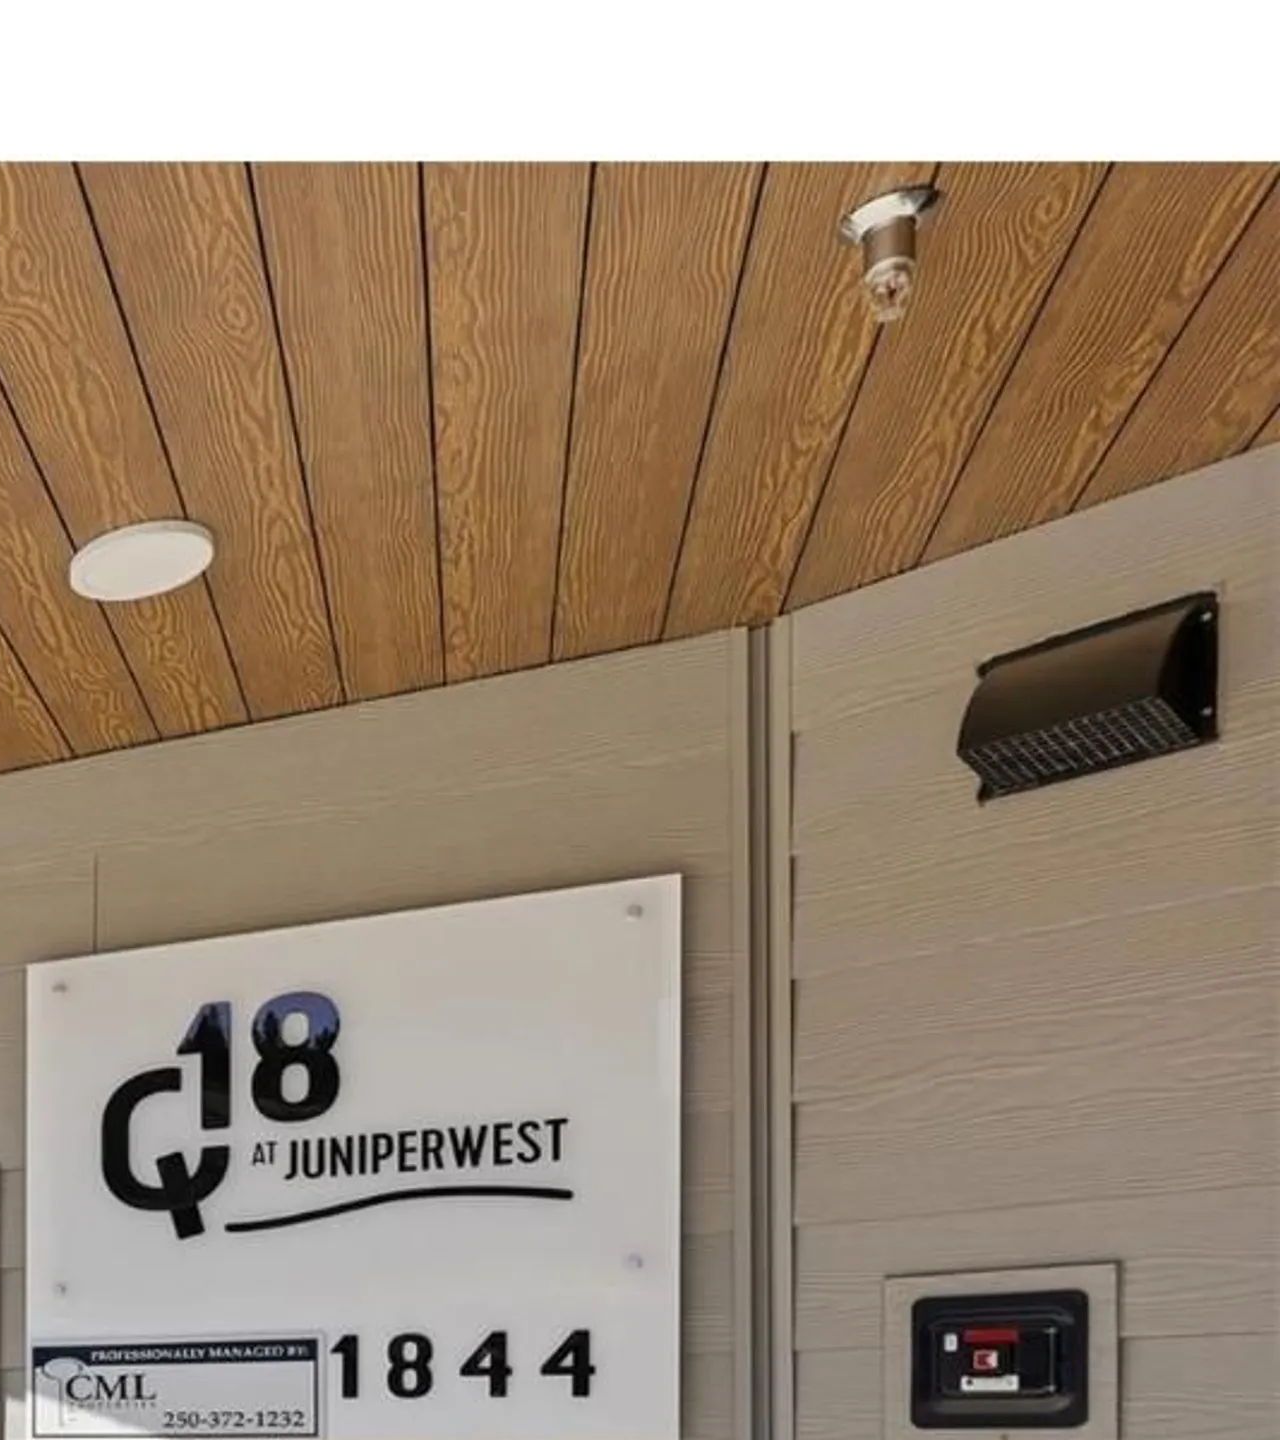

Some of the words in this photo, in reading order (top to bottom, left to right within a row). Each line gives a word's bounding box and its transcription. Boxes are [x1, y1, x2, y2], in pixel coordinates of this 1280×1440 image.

[252, 1140, 279, 1166] AT
[285, 1118, 569, 1181] JUNIPERWEST
[91, 1347, 206, 1362] PROFESSIONALLY
[207, 1345, 285, 1358] MANAGED
[329, 1329, 596, 1399] 1844
[66, 1372, 158, 1401] CML
[163, 1409, 306, 1429] 250-372-1232
